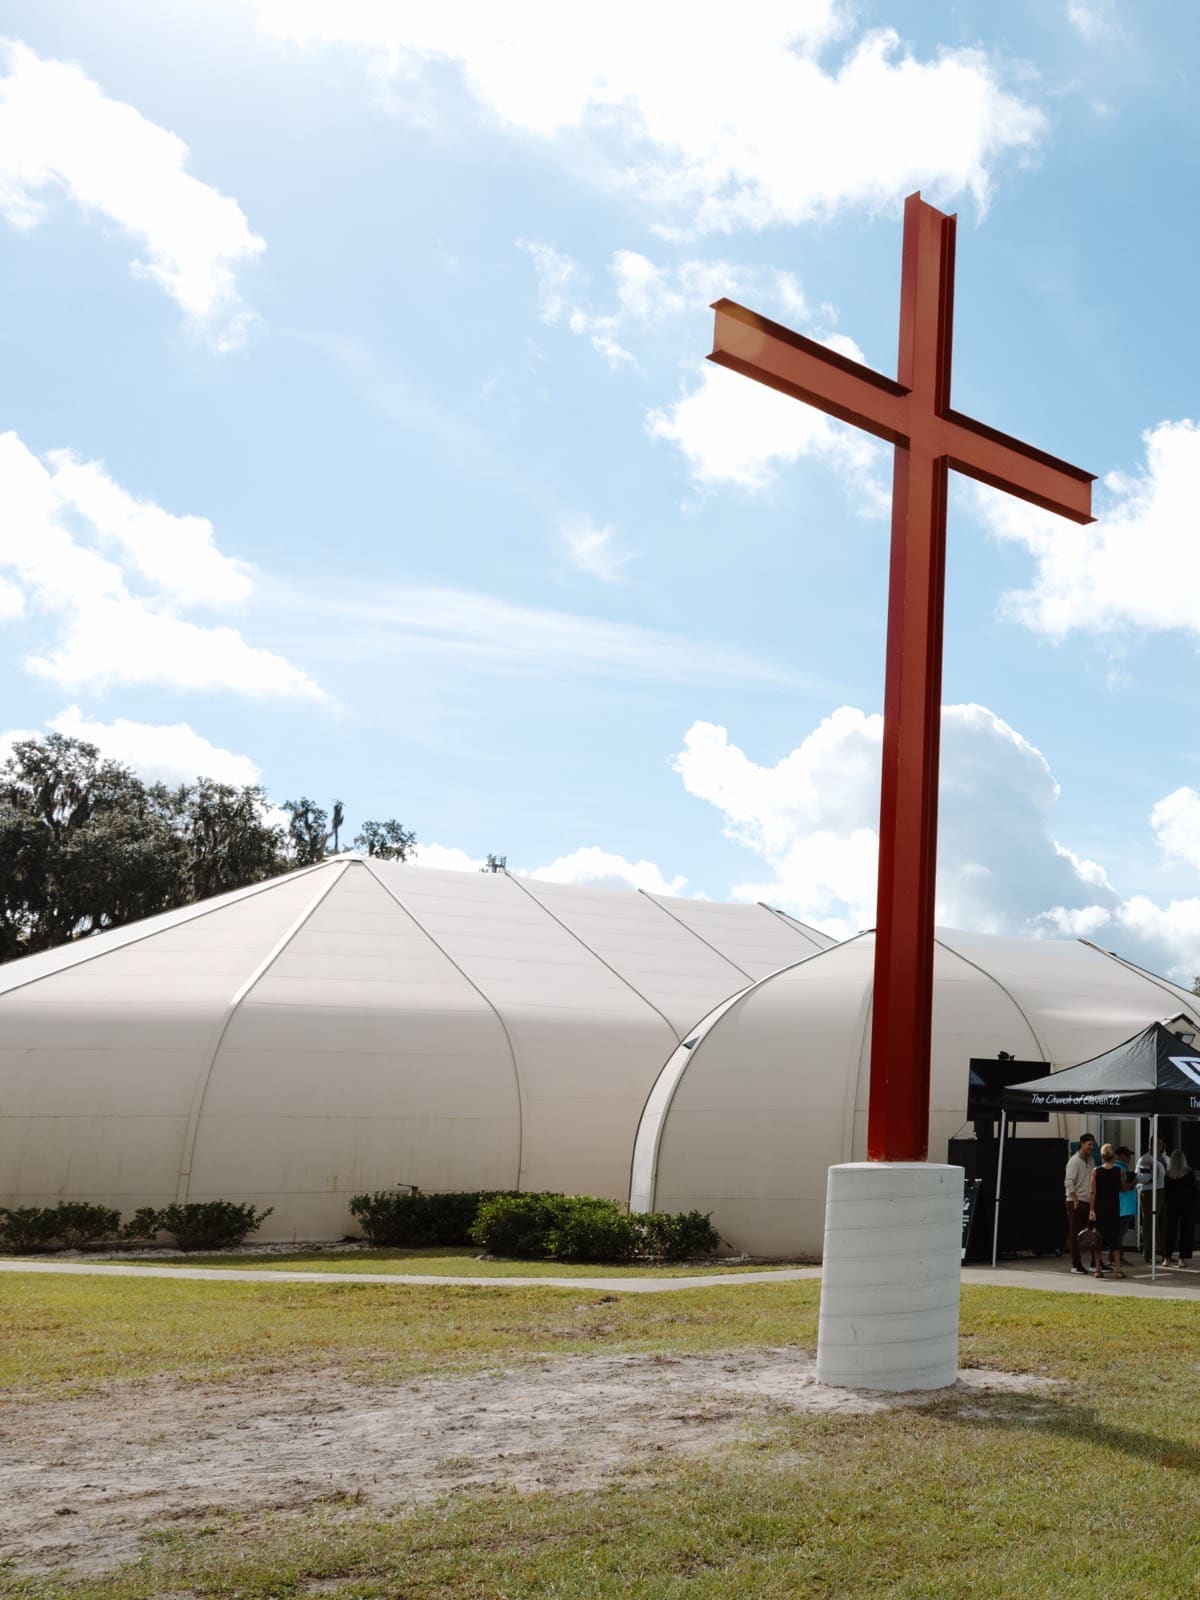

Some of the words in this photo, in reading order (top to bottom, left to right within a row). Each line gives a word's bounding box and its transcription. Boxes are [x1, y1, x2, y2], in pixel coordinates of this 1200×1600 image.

[1031, 1093, 1045, 1104] The
[1045, 1094, 1073, 1105] Church
[1073, 1094, 1083, 1105] of
[1083, 1094, 1121, 1106] Eleven22
